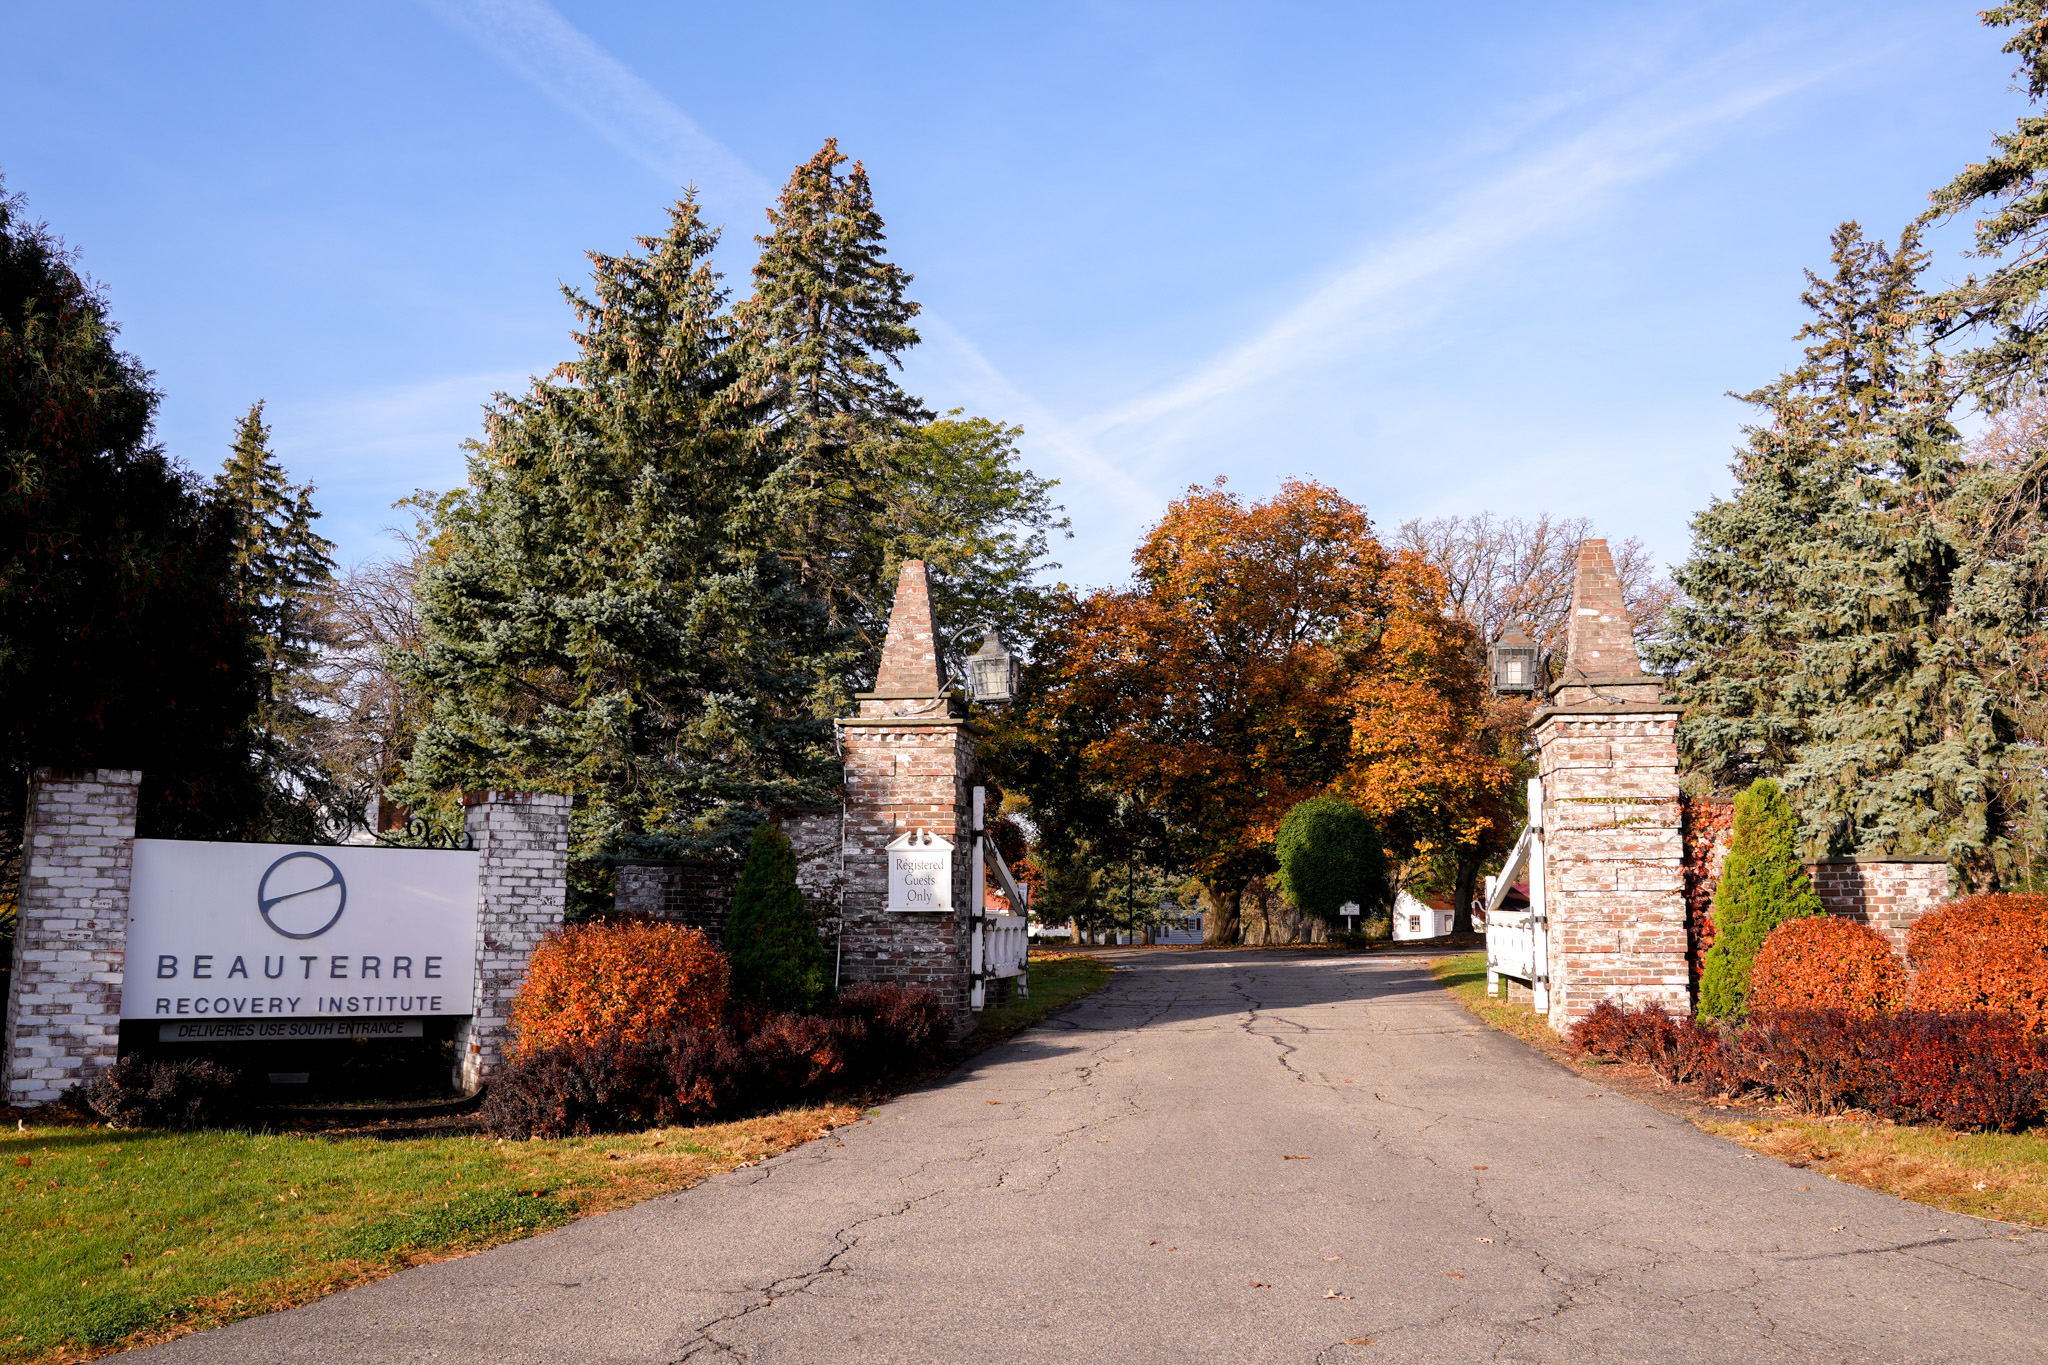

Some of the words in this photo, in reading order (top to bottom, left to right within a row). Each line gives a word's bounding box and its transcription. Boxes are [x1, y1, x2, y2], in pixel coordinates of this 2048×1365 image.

[896, 858, 943, 873] Registered
[904, 874, 935, 886] Guests
[907, 889, 932, 904] Only
[156, 955, 442, 979] BEAUTERRE
[155, 997, 301, 1014] RECOVERY
[318, 996, 442, 1012] INSTITUTE
[178, 1023, 256, 1038] DELIVERIES
[259, 1023, 287, 1037] USE
[289, 1022, 334, 1036] SOUTH
[337, 1022, 404, 1035] ENTRANCE
